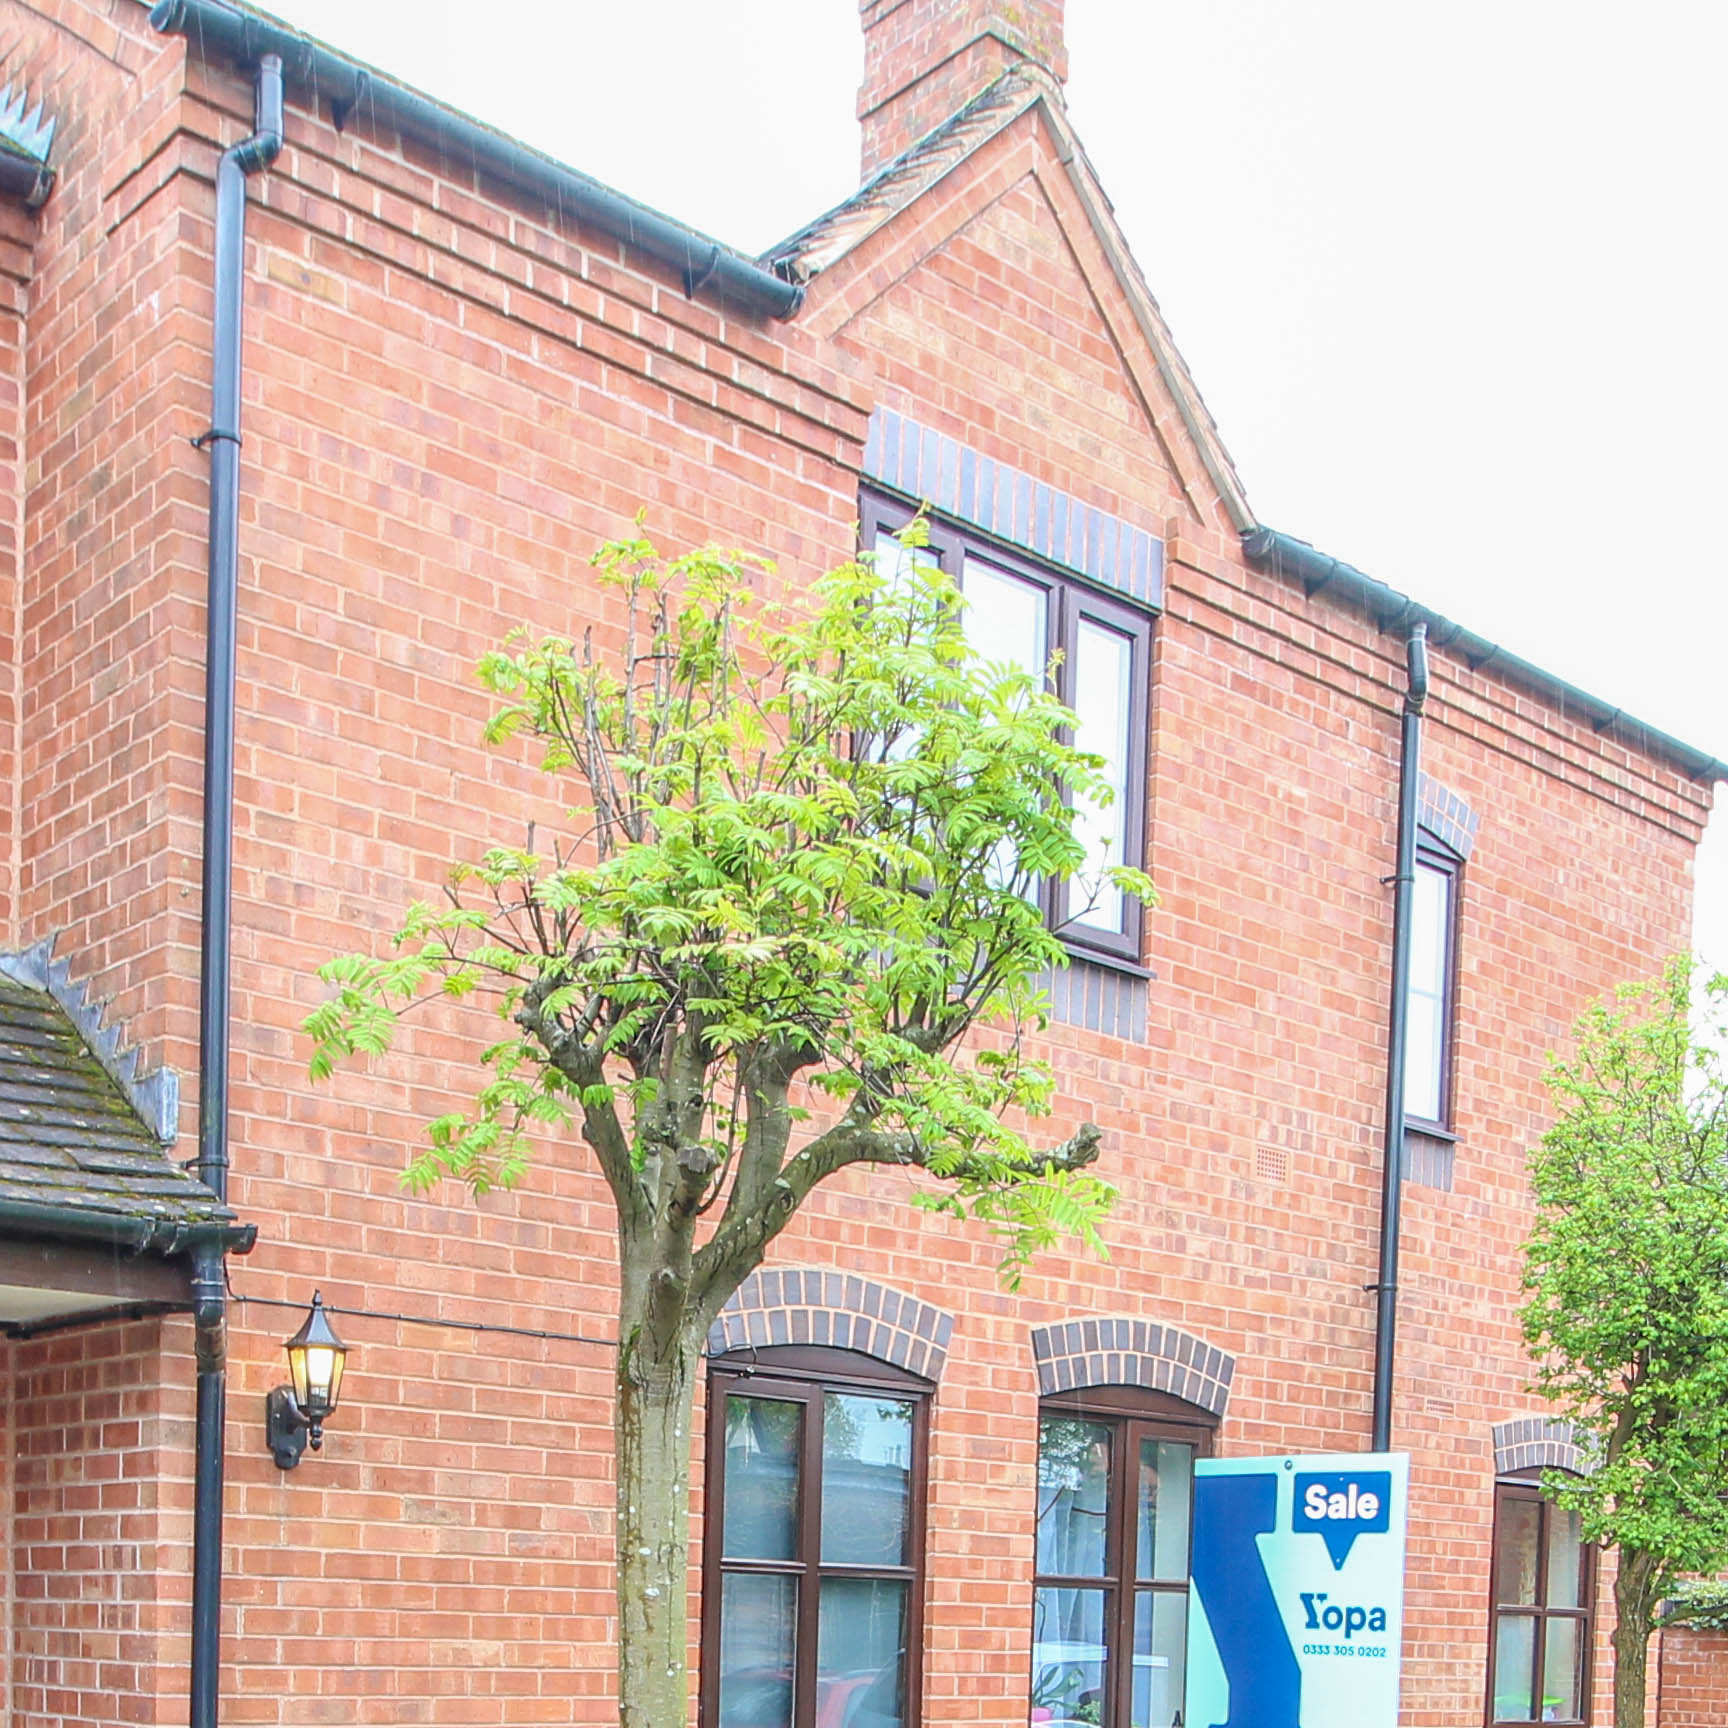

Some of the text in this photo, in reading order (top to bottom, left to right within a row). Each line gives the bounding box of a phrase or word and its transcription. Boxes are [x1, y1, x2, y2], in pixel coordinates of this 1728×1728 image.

[1303, 1483, 1380, 1520] Sale
[1299, 1593, 1387, 1639] Yopa
[1303, 1644, 1386, 1657] 0333 305 0202
